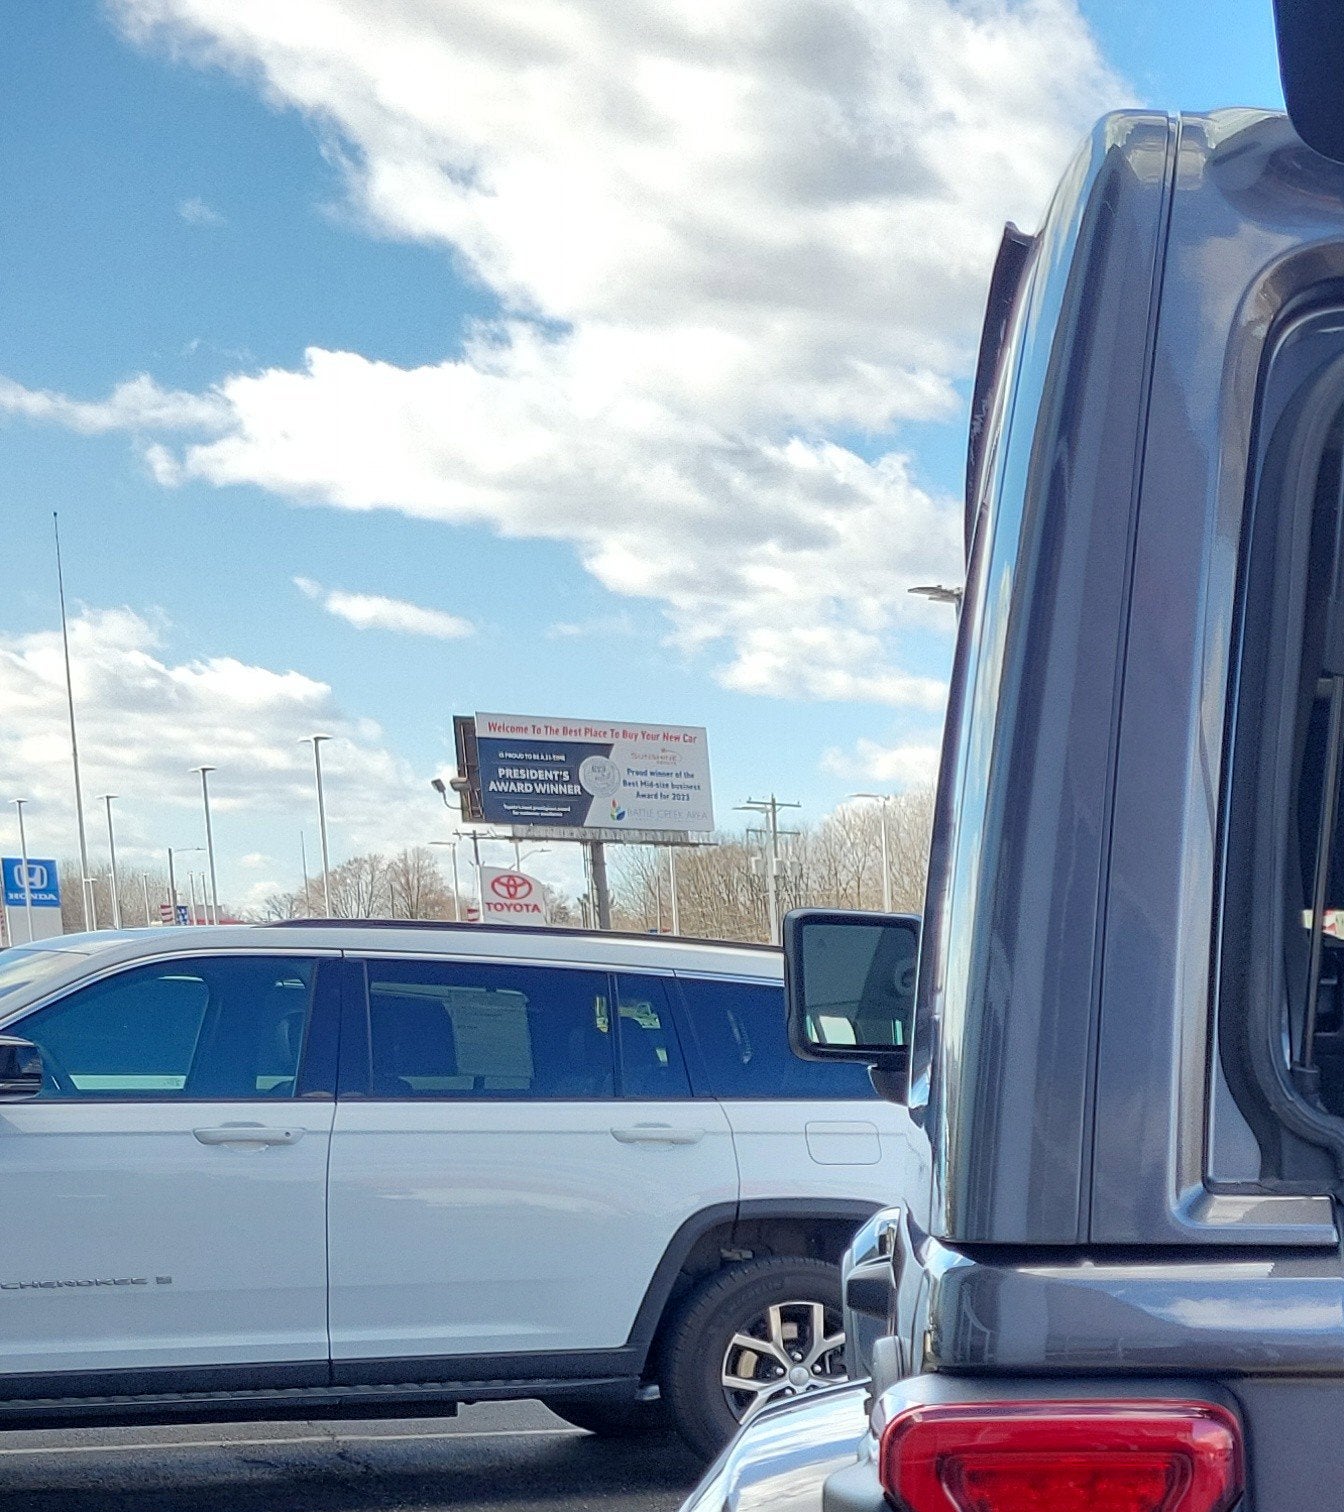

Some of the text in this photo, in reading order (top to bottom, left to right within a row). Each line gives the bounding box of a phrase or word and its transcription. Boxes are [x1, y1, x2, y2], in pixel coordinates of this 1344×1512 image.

[487, 721, 698, 744] Welcome To The Best Place To Buy Your New Car
[497, 767, 570, 782] PRESIDENT'S
[626, 768, 648, 777] Proud
[683, 771, 695, 779] the
[488, 780, 582, 796] AWARD WINNER
[622, 779, 639, 788] Best
[636, 791, 659, 800] Award
[8, 893, 58, 901] HONDA
[485, 902, 542, 913] TOYOTA
[0, 1277, 149, 1290] CHEROKEE
